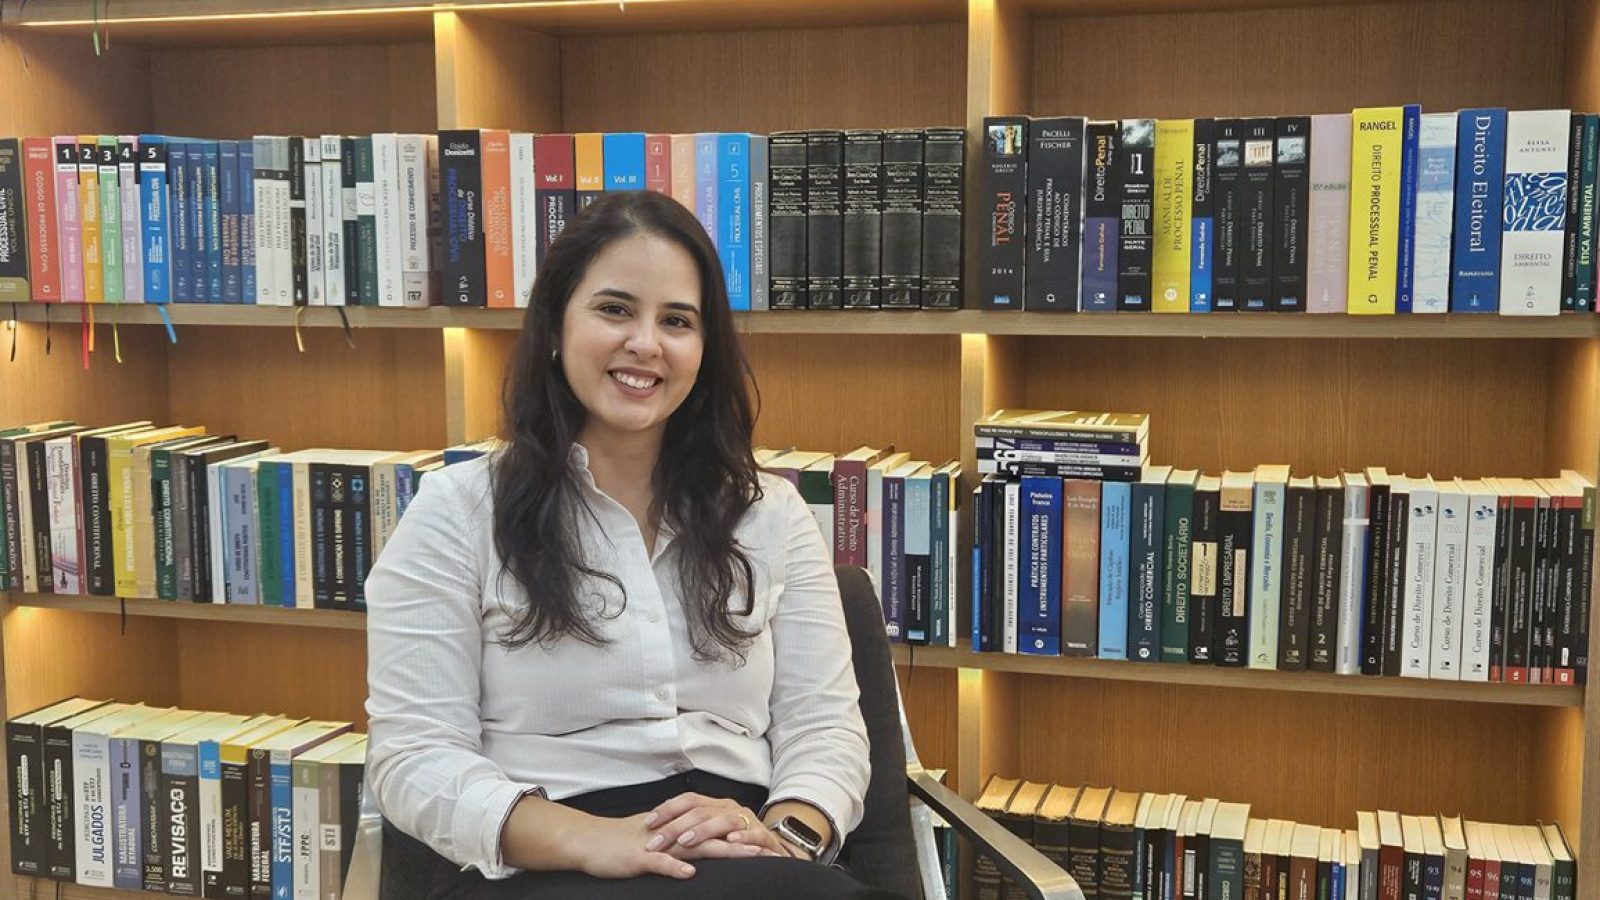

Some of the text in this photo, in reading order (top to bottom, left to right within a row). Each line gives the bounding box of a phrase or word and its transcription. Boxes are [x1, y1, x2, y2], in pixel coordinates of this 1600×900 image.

[1225, 128, 1232, 136] II
[1254, 128, 1264, 136] III
[1287, 124, 1298, 132] IV
[1360, 121, 1396, 131] RANGEL
[62, 148, 70, 160] 1
[83, 148, 91, 159] 2
[103, 151, 112, 161] 3
[121, 148, 130, 158] 4
[147, 148, 156, 158] 5
[730, 164, 739, 178] 5
[1094, 136, 1106, 202] DireitoPenal
[1135, 154, 1144, 174] 1
[1195, 144, 1206, 202] DireitoPenal
[546, 174, 557, 182] Vol.
[614, 176, 626, 184] Vol.
[1046, 178, 1054, 216] PROCESSO
[1470, 115, 1491, 252] Direito Eleitoral
[457, 190, 468, 241] de DIREITO
[754, 182, 763, 275] PROCEDIMENTOS ESPECIAIS
[996, 192, 1010, 245] PENAL
[1053, 192, 1062, 248] AO CÓDIGO DE
[1062, 194, 1070, 247] COMENTÁRIOS
[1122, 204, 1150, 220] DIREITO
[1124, 220, 1146, 234] PENAL
[1162, 178, 1172, 234] MANUAL DE
[1174, 160, 1184, 251] PROCESSO PENAL
[1368, 144, 1382, 280] DIREITO PROCESSUAL PENAL
[1580, 184, 1594, 265] ÉTICA AMBIENTAL
[450, 238, 460, 262] CIVIL
[90, 472, 101, 569] DIREITO CONSTITUCIONAL
[161, 480, 173, 566] DIREITO CONSTITUCIONAL
[837, 474, 847, 551] Administrativo
[848, 476, 860, 551] Curso de Direito
[1031, 551, 1039, 560] DE
[1040, 515, 1048, 560] PARTICULARES
[1030, 562, 1039, 587] PRÁTICA
[1146, 552, 1155, 600] COMERCIAL
[1176, 518, 1189, 623] DIREITO SOCIETÁRIO
[1222, 533, 1233, 616] DIREITO EMPRESARIAL
[1412, 542, 1425, 648] Curso de Direito Comercial
[1442, 544, 1455, 651] Curso de Direito Comercial
[1472, 545, 1486, 653] Curso de Direito Comercial
[1319, 634, 1326, 644] 2
[91, 806, 104, 864] JULGADOS
[118, 804, 126, 864] MAGISTRATURA
[128, 828, 136, 864] ESTADUAL
[170, 789, 187, 878] REVISAÇO
[252, 821, 260, 881] MAGISTRATURA
[278, 808, 291, 863] STF/STJ
[1427, 866, 1439, 875] 93
[1503, 875, 1515, 883] 97
[1520, 876, 1532, 884] 98
[1558, 876, 1572, 884] 101
